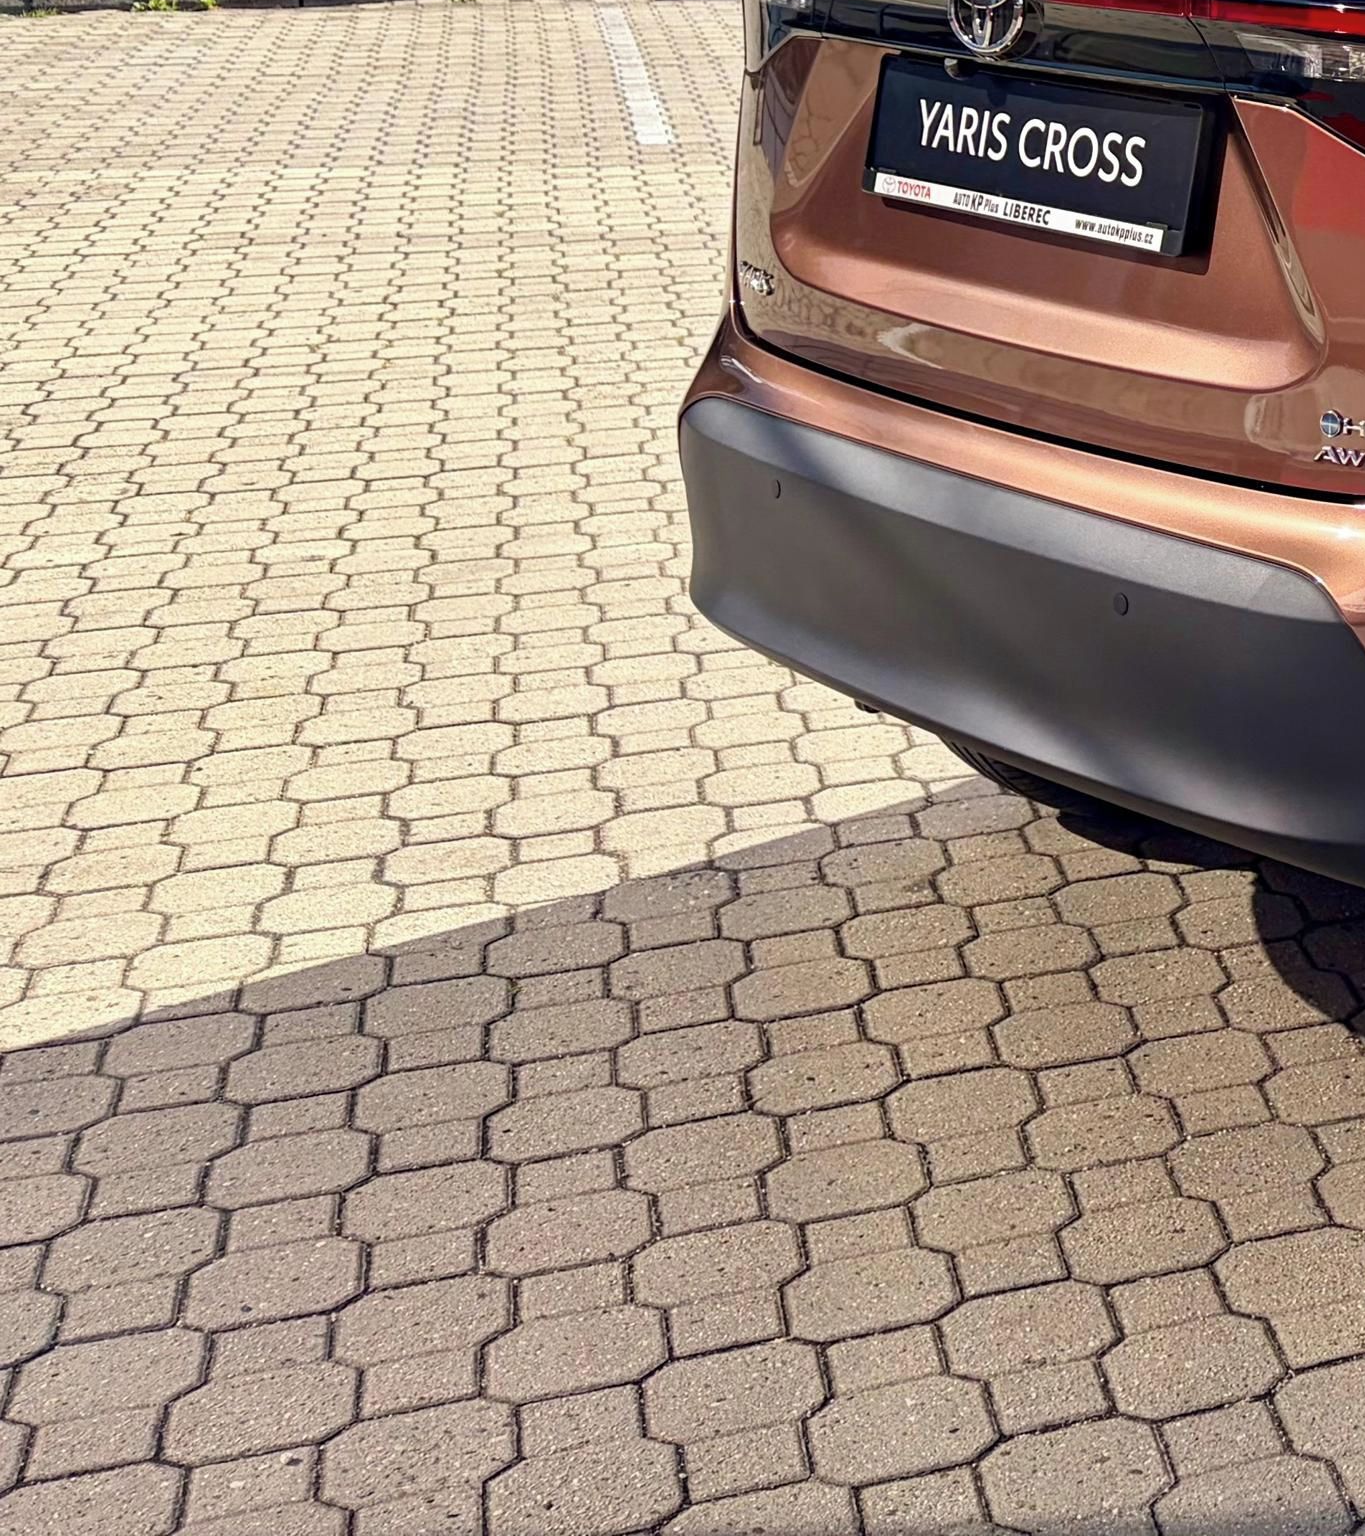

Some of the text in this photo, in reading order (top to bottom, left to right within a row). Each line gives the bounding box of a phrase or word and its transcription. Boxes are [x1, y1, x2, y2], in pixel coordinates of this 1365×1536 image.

[919, 99, 1146, 187] YARIS CROSS
[897, 180, 932, 200] TOYOTA
[953, 192, 970, 208] AUTO
[970, 193, 984, 212] KP
[1003, 201, 1051, 225] LIBEREC
[1075, 219, 1154, 244] www.autokpplus.cz
